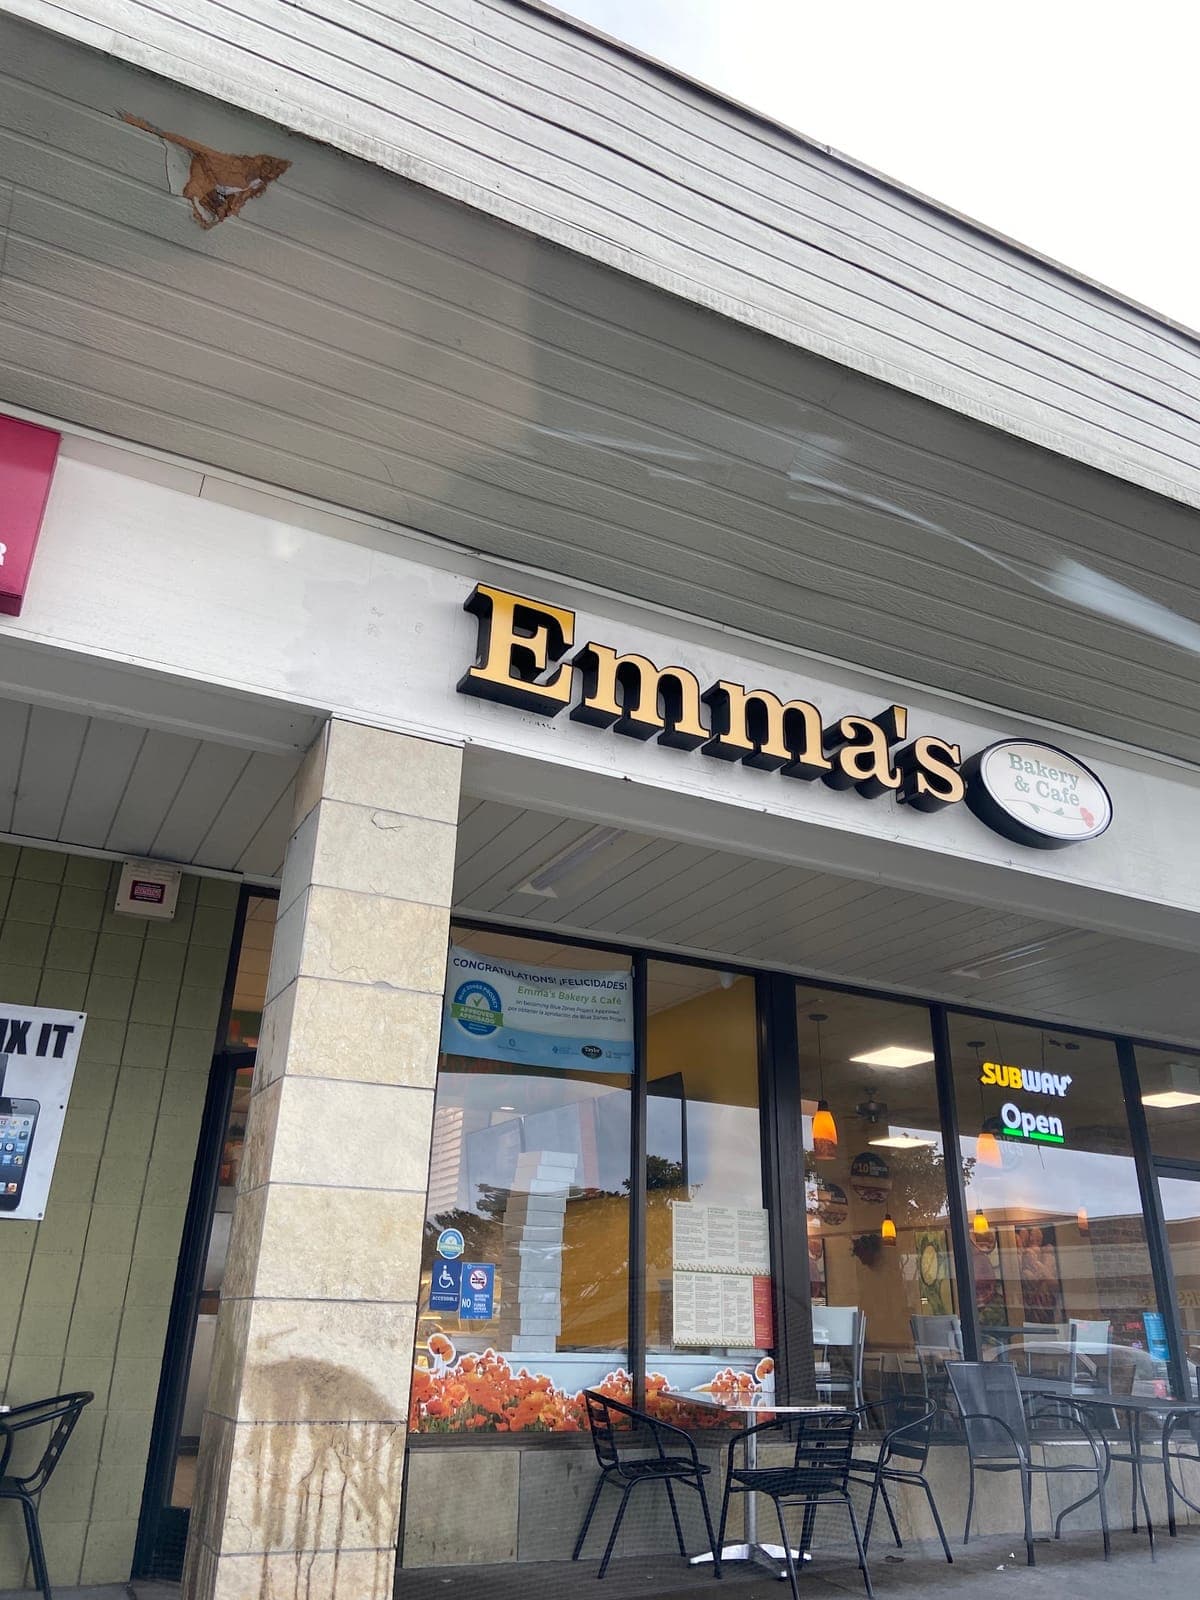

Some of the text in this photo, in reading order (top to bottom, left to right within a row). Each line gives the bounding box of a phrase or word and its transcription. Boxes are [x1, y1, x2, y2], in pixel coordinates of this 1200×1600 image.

[468, 583, 967, 805] Emma's
[1008, 752, 1079, 790] Bakery
[1015, 775, 1030, 793] &
[453, 958, 628, 991] CONGRATULATIONS! ¡FELICIDADES!
[517, 985, 556, 998] Emma's
[558, 991, 589, 1004] Bakery
[591, 995, 597, 1003] &
[36, 1023, 75, 1058] IT
[980, 1062, 1072, 1097] SUBWAY
[1001, 1103, 1064, 1137] Open
[461, 1298, 471, 1308] NO
